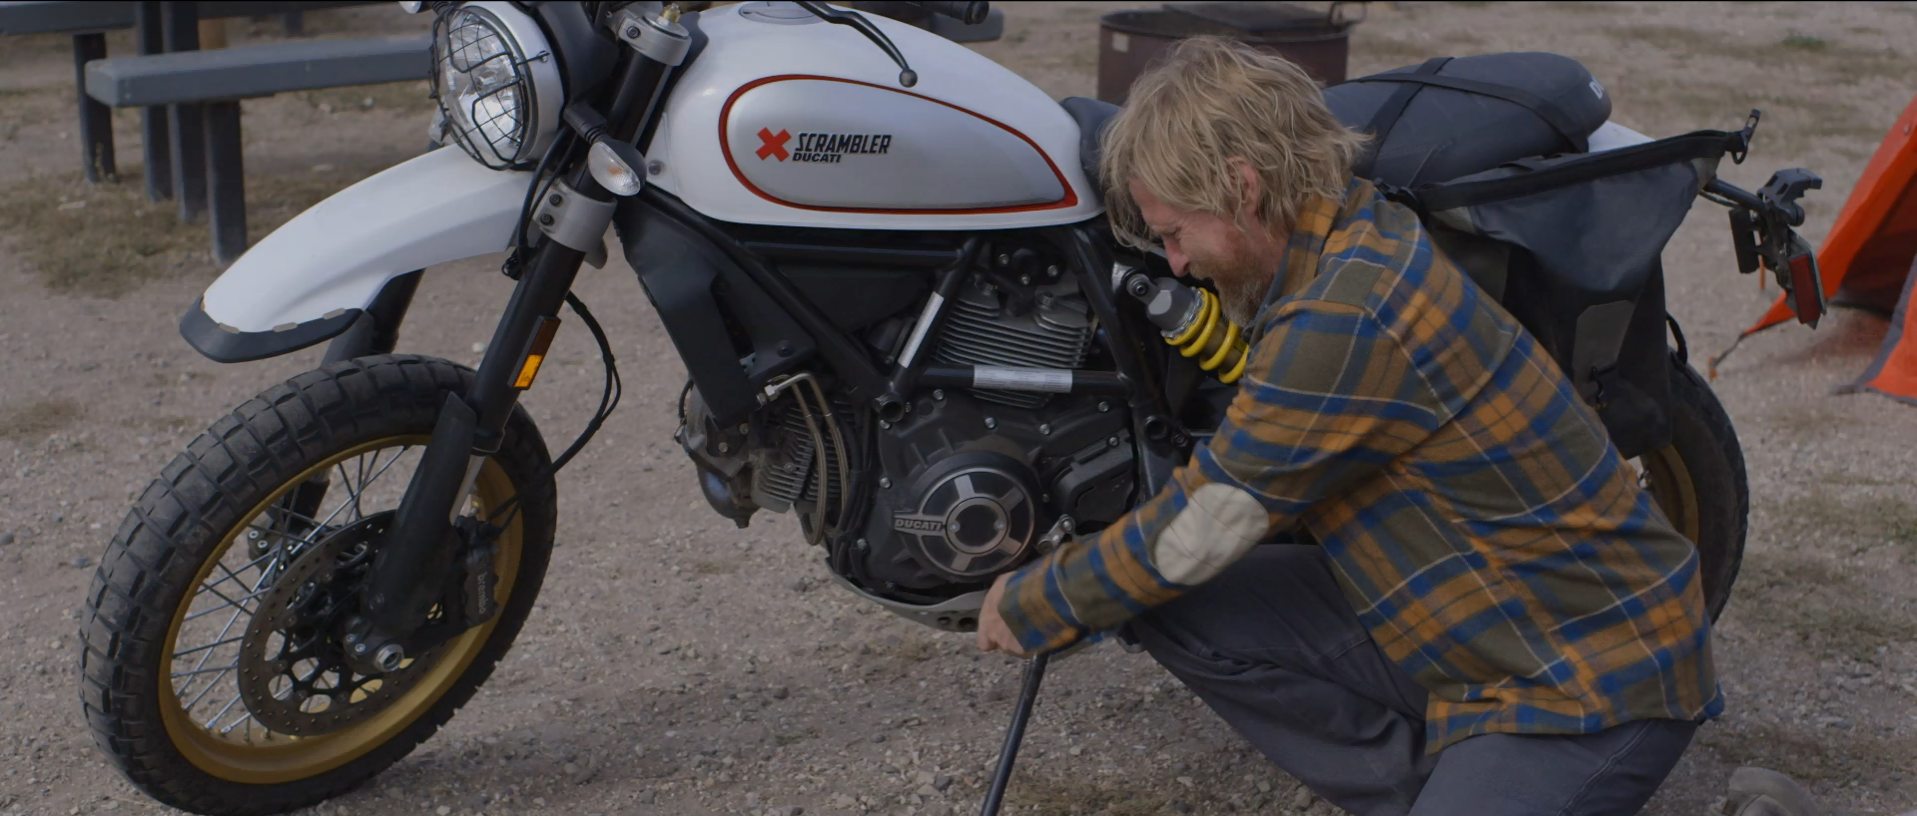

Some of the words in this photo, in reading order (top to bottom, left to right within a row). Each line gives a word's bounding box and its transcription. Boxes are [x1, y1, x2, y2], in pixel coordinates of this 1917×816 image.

[794, 132, 892, 155] SCRAMBLER
[792, 153, 842, 164] DUCATI
[894, 519, 942, 532] DUCATI
[477, 571, 489, 615] brembo
